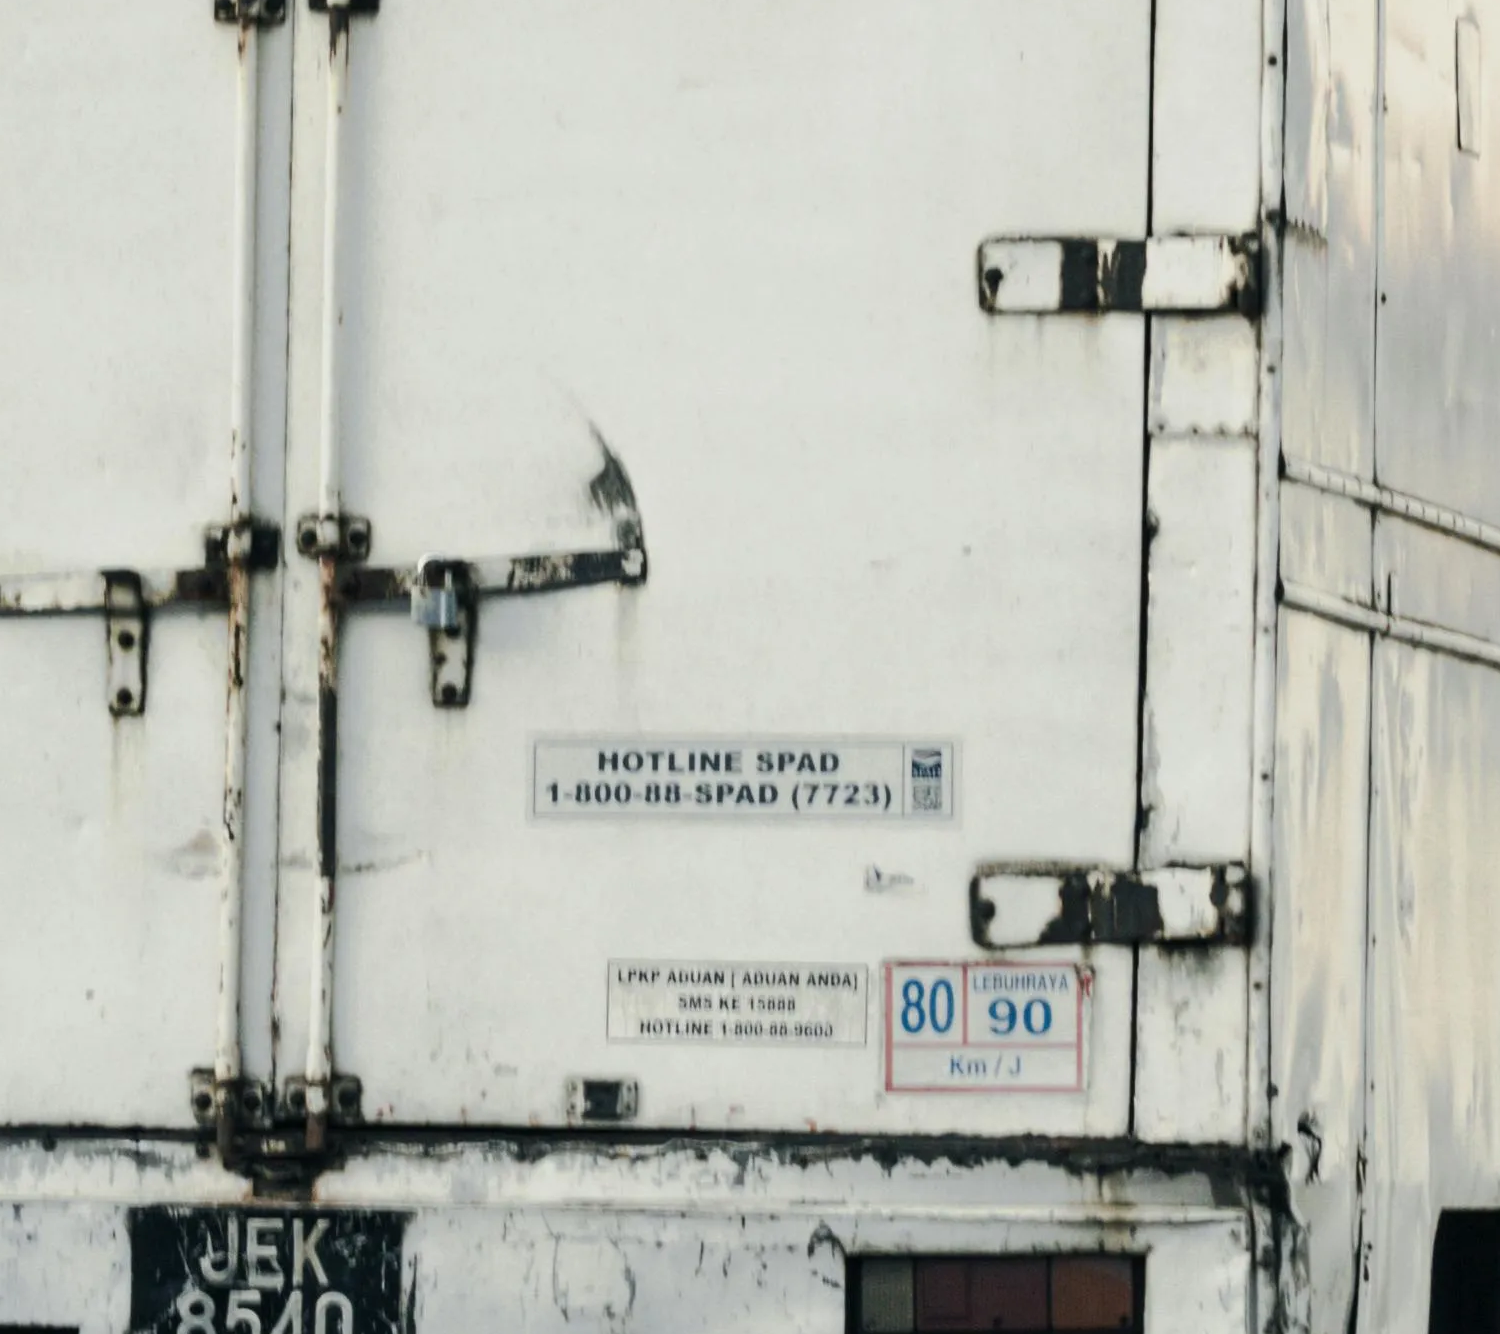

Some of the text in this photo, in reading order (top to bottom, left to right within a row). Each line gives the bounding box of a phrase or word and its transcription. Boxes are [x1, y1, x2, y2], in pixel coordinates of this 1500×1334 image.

[597, 750, 840, 774] HOTLINE SPAD
[546, 781, 779, 806] 1-800-88-SPAD
[791, 782, 892, 810] (7723)
[666, 969, 726, 985] ADUAN
[741, 971, 800, 986] ADUAN
[678, 995, 713, 1011] SMS
[718, 995, 741, 1011] KE
[900, 973, 1070, 1034] 80 LEBUHRAYA
[639, 1018, 714, 1036] HOTLINE
[987, 997, 1053, 1036] 90
[949, 1054, 987, 1077] Km
[1008, 1054, 1022, 1077] J
[199, 1216, 331, 1290] JEK
